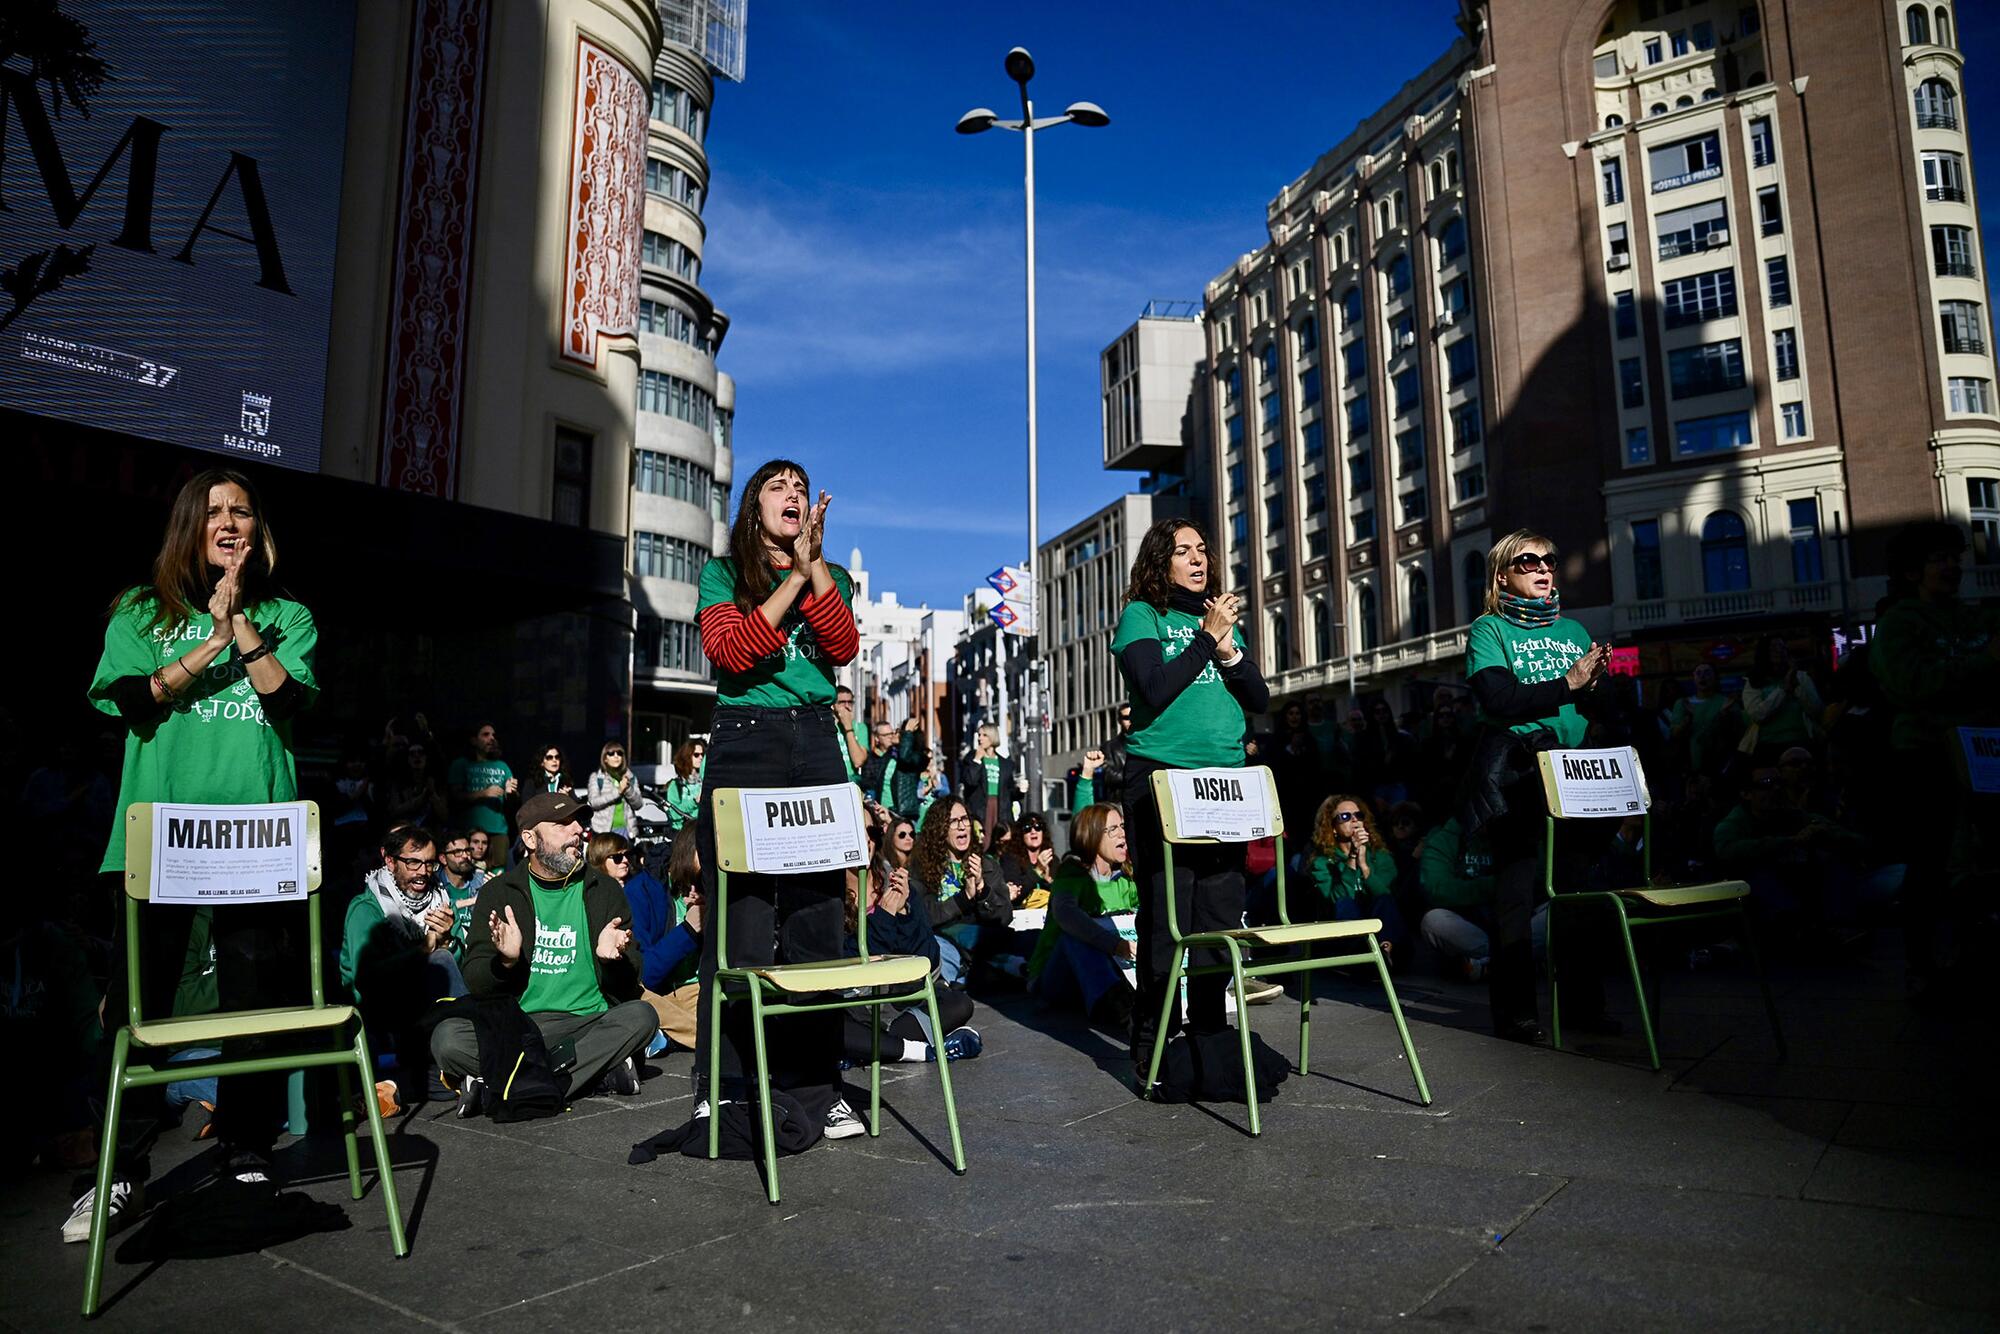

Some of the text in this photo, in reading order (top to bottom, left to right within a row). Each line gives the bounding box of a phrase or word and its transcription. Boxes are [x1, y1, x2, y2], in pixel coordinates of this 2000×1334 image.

[1653, 166, 1721, 191] HOSTAL LA PRENSA
[138, 360, 178, 388] 27
[1562, 754, 1623, 780] ÁNGELA
[1193, 778, 1244, 801] AISHA
[765, 797, 835, 828] PAULA
[168, 817, 292, 849] MARTINA
